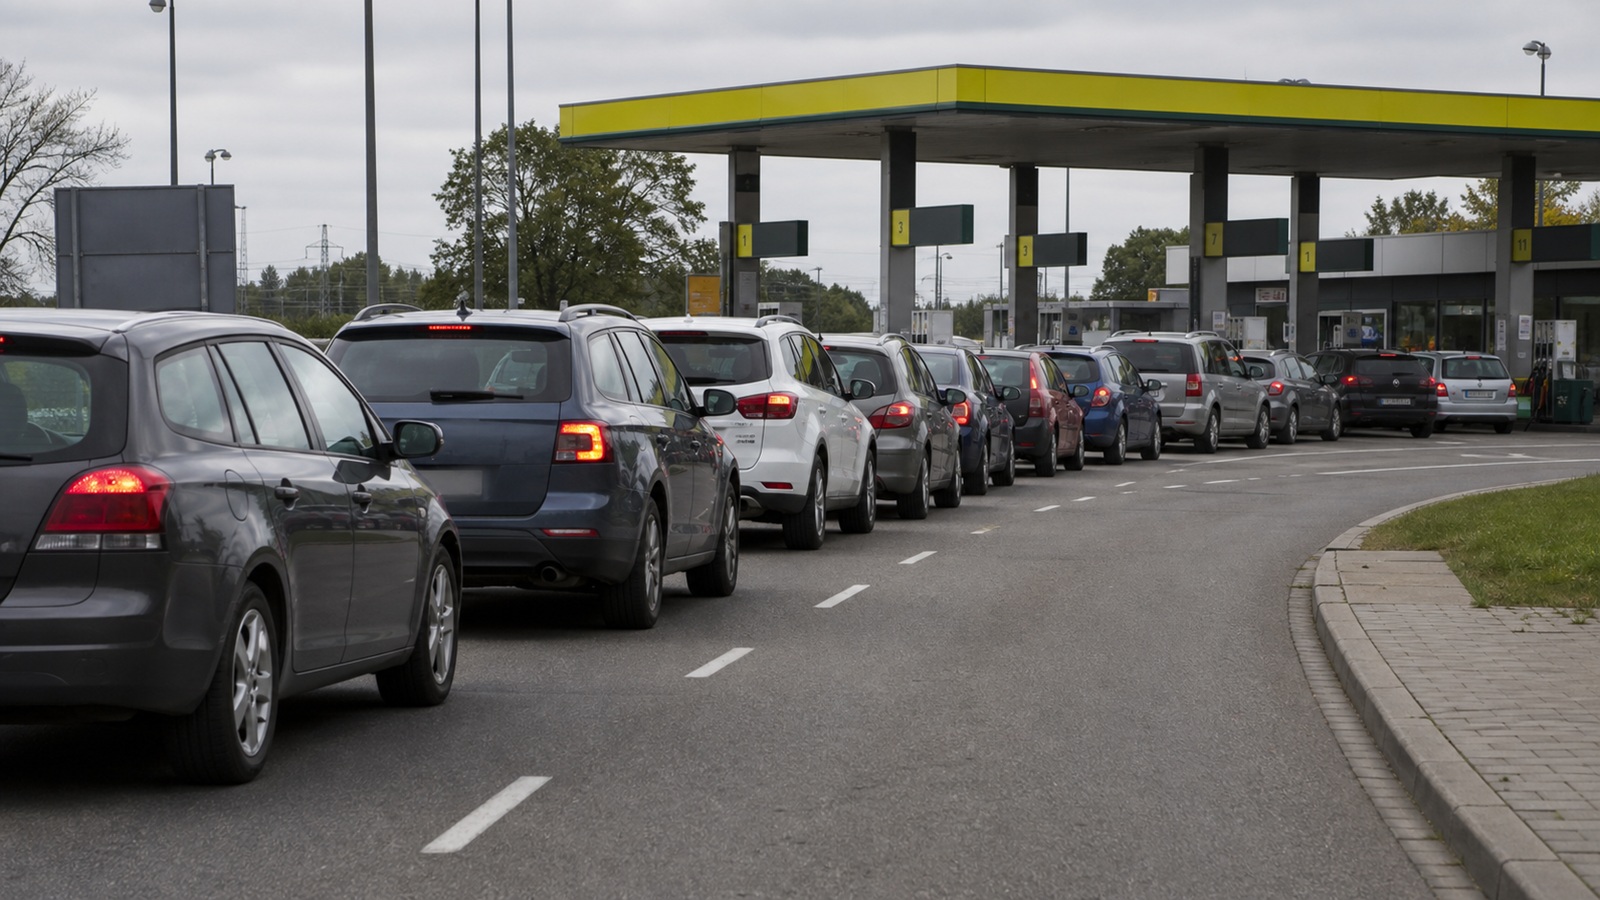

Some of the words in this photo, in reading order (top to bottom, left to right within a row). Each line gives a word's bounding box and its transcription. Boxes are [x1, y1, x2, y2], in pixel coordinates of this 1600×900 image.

[898, 221, 903, 234] 3
[1211, 233, 1217, 245] 7
[1516, 239, 1527, 251] 11
